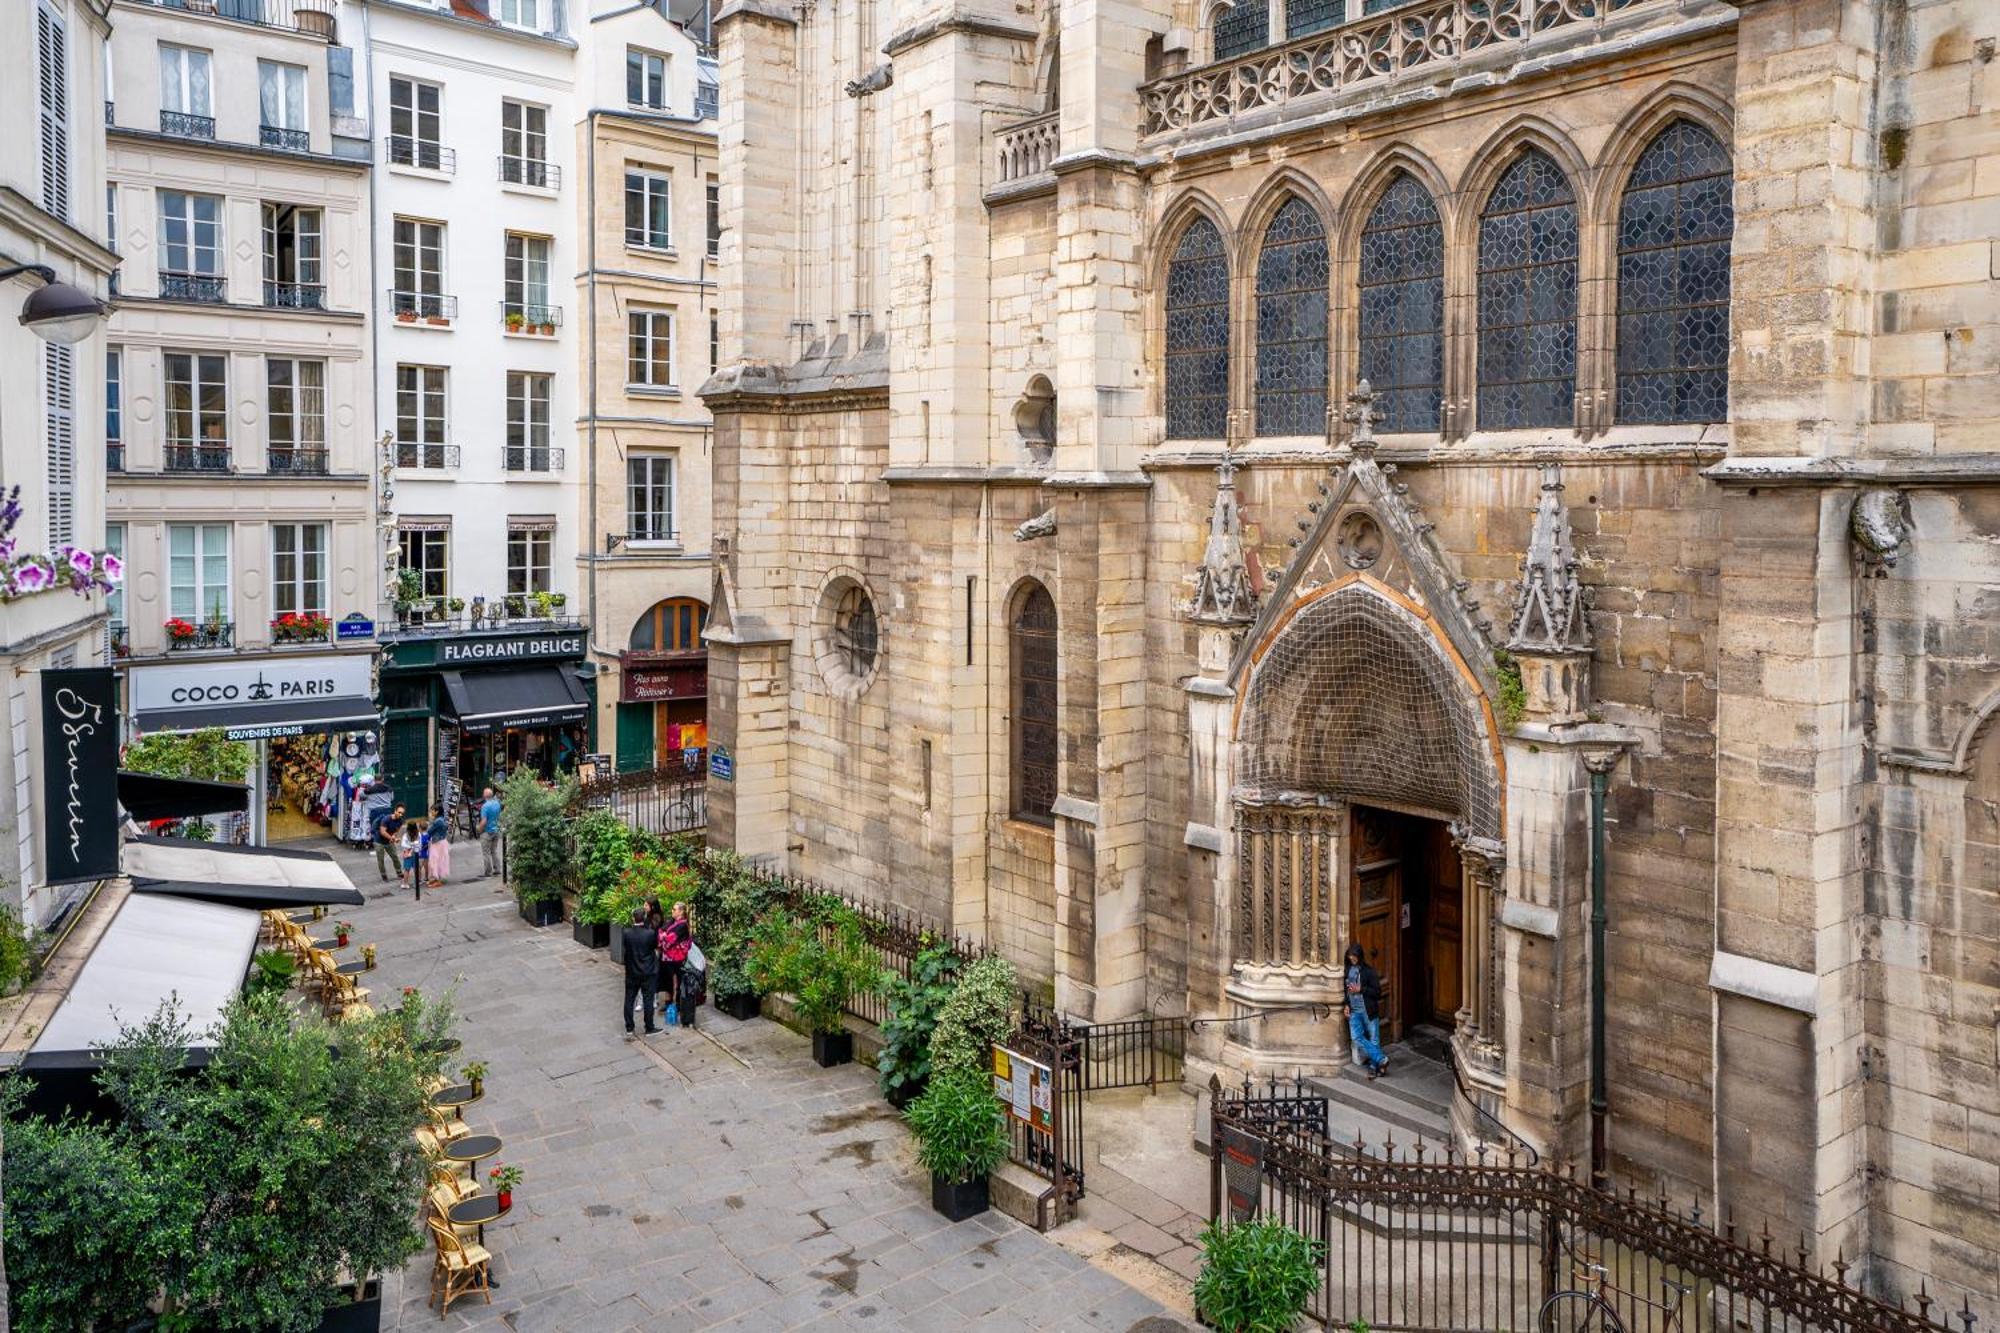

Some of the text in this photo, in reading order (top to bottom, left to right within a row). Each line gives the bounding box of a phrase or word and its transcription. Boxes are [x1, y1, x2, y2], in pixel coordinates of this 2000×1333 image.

[444, 639, 580, 660] FLAGRANT DELICE
[171, 679, 334, 703] COCO PARIS
[228, 726, 303, 740] SOUVENIRS DE PARIS
